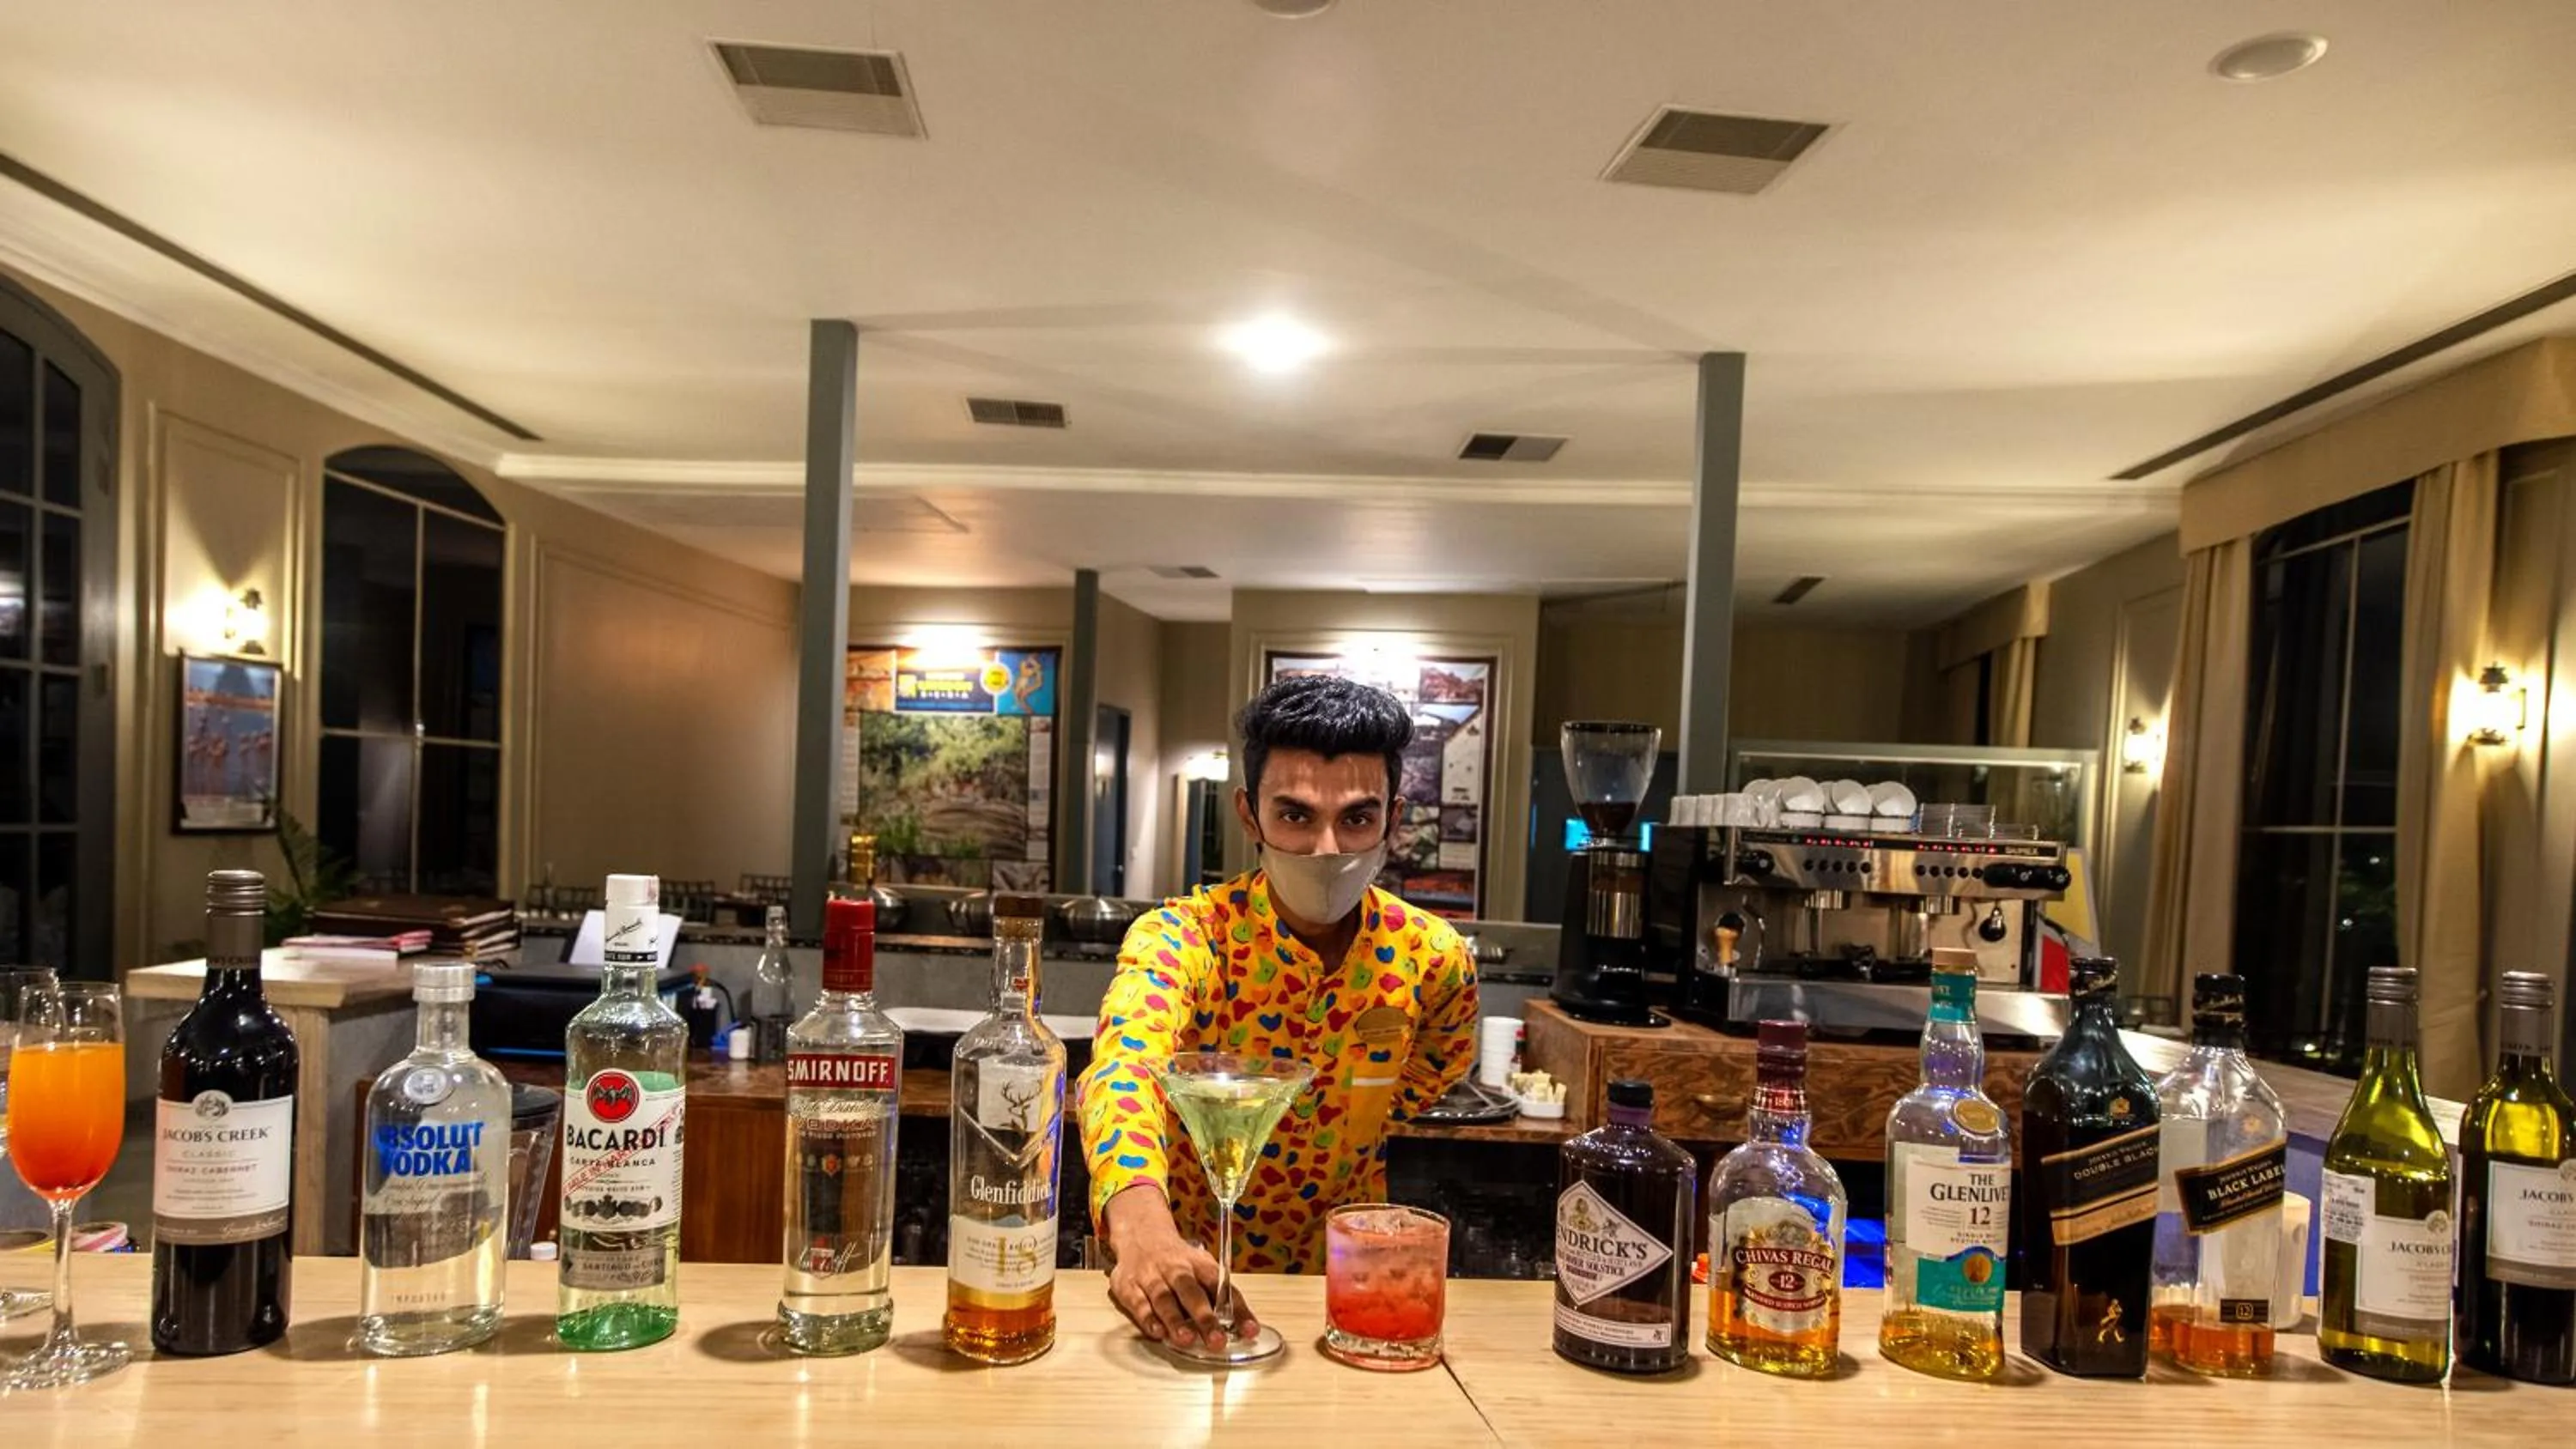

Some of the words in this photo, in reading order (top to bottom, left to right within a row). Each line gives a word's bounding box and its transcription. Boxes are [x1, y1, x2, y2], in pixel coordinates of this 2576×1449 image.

[787, 1059, 890, 1082] SMIRNOFF
[217, 1126, 269, 1143] CREEK
[379, 1148, 471, 1177] VODKA
[1970, 1173, 1995, 1186] THE
[2207, 1178, 2249, 1200] BLACK
[2251, 1163, 2286, 1185] LABEL
[1929, 1182, 2008, 1203] GLENLIVE
[1969, 1206, 1991, 1225] 12
[1735, 1249, 1789, 1264] CHIVAS
[1792, 1251, 1832, 1272] REGAL
[1779, 1274, 1795, 1288] 12
